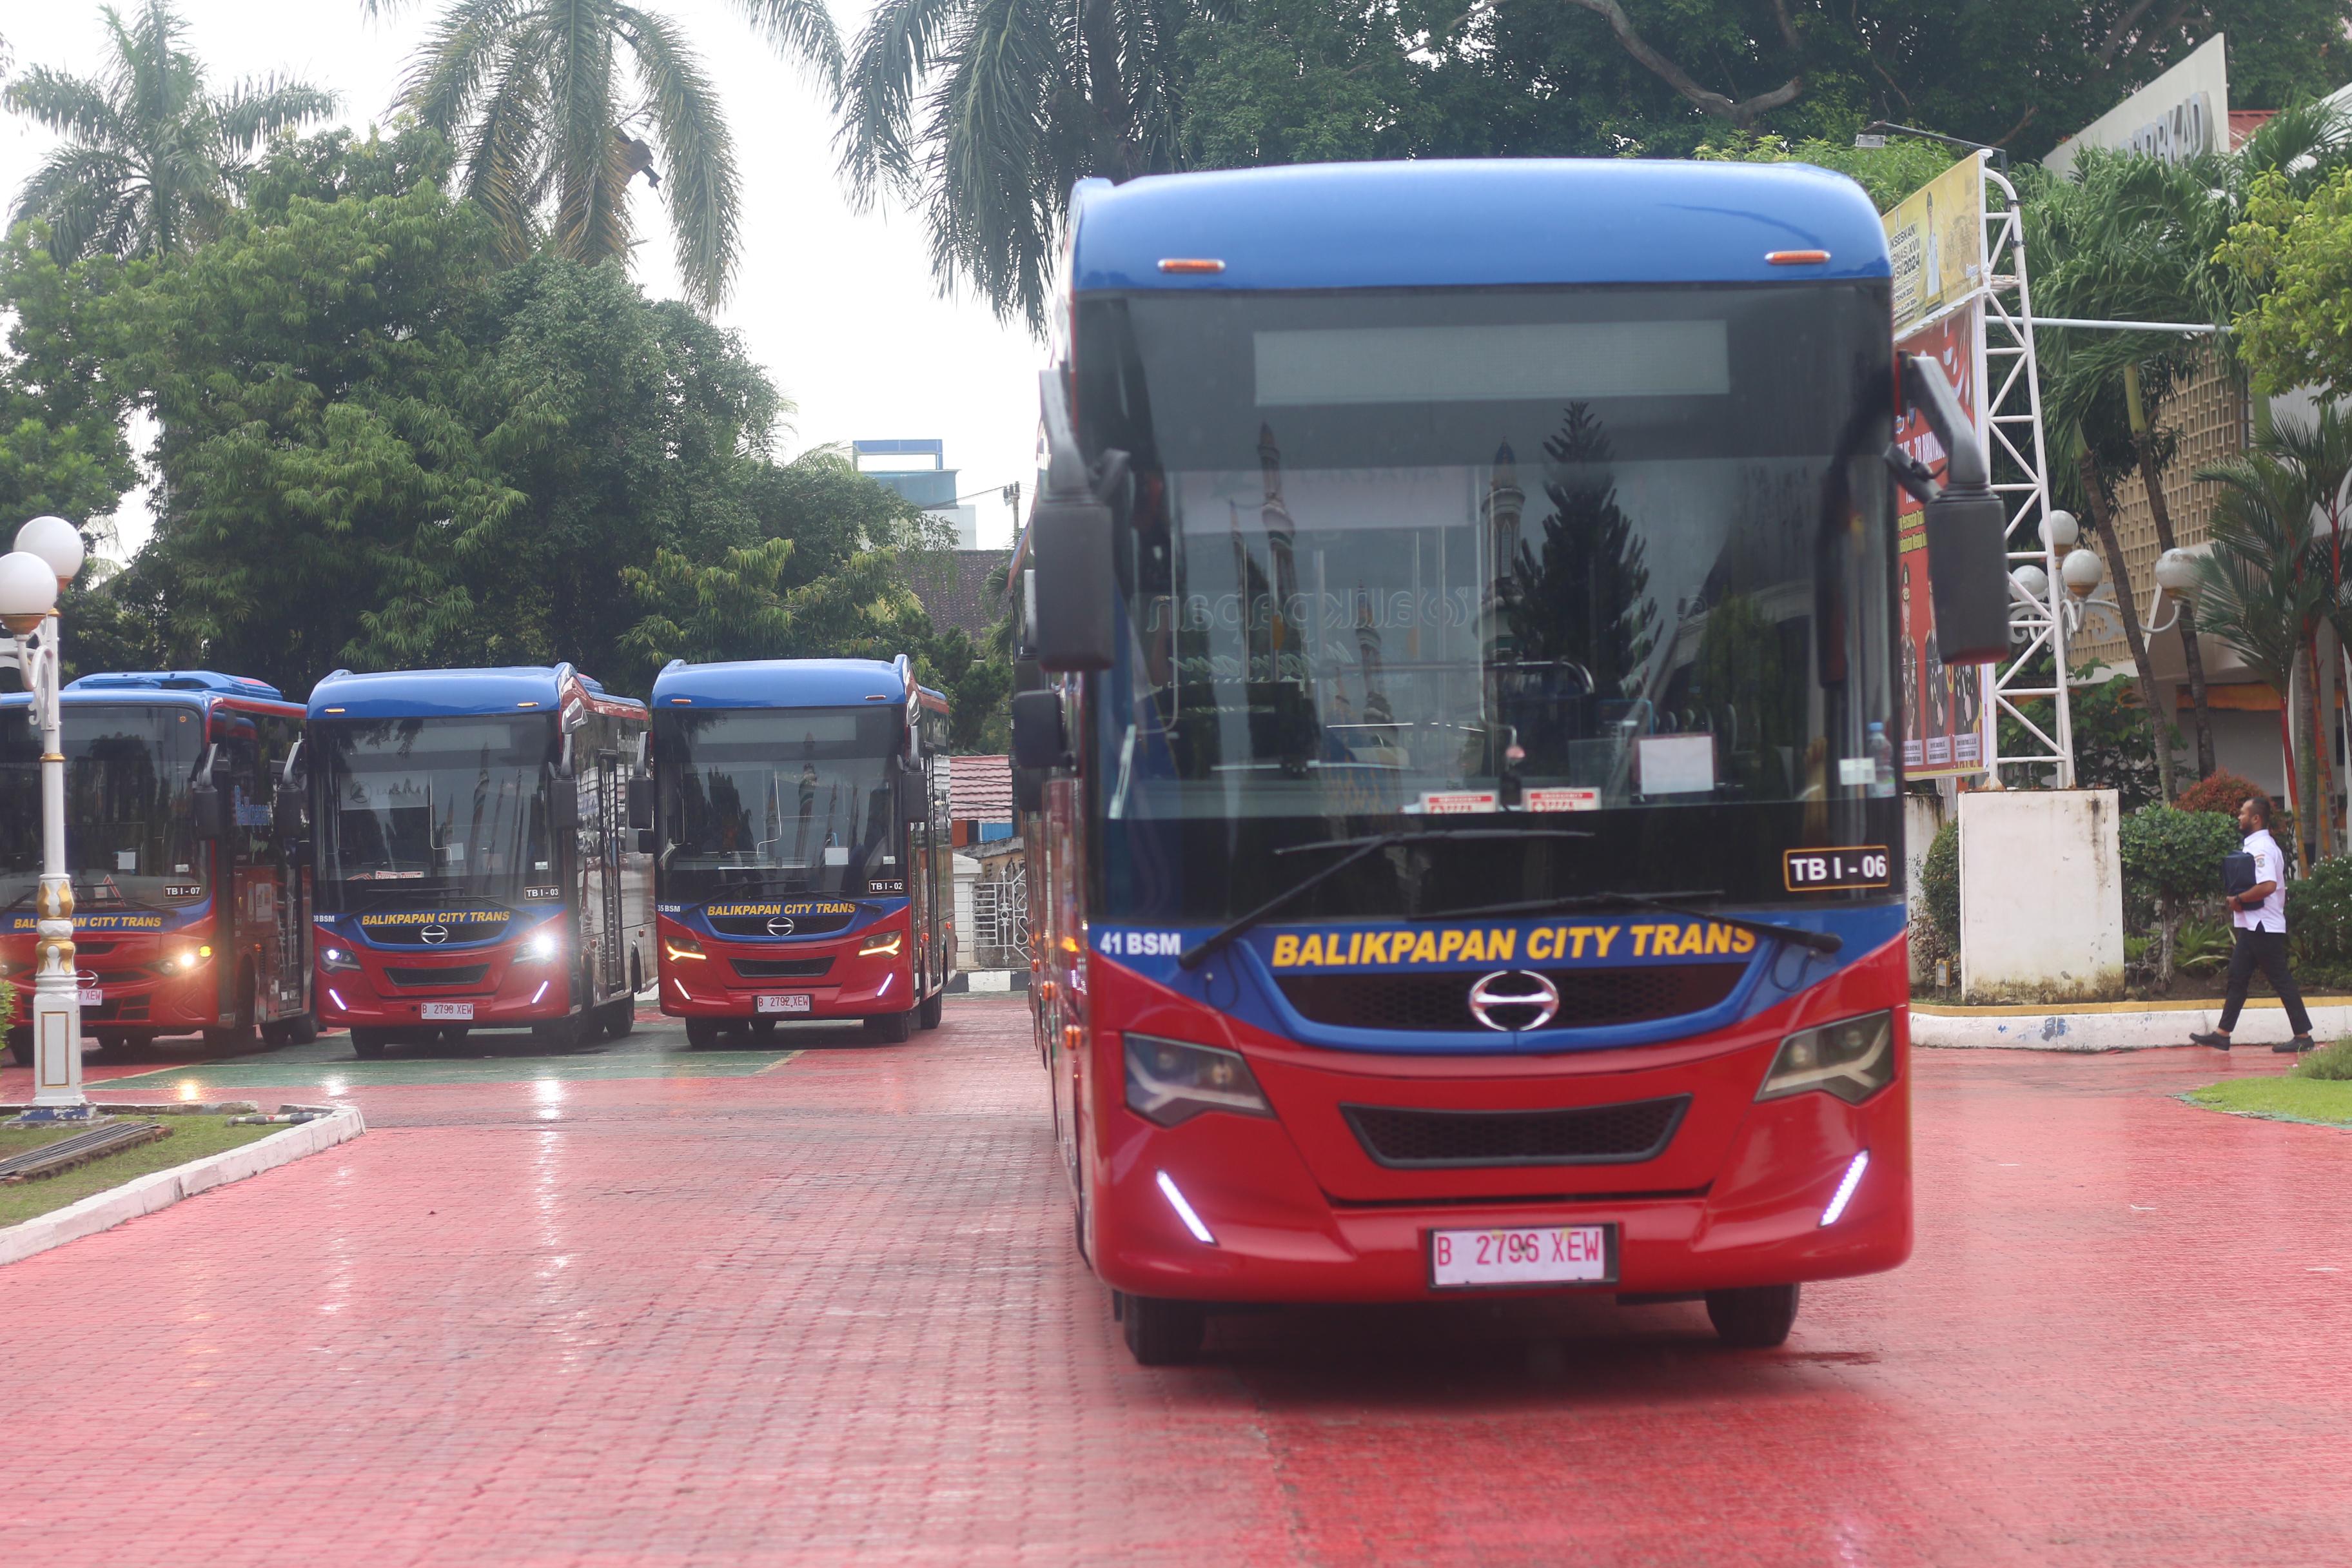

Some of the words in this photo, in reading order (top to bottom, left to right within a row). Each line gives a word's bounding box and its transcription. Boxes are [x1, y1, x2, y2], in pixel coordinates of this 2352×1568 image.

[1888, 223, 1916, 251] UKSESKAN
[1903, 252, 1920, 276] 2024
[1790, 858, 1827, 881] TB
[1862, 856, 1886, 877] 06
[550, 888, 558, 896] 03
[707, 905, 781, 916] BALIKPAPAN
[783, 903, 812, 915] CITY
[816, 903, 856, 914] TRANS
[14, 917, 86, 929] BALIAN
[89, 917, 119, 927] CITY
[121, 917, 161, 927] TRANS
[362, 914, 435, 925] BALIKPAPAN
[438, 913, 466, 923] CITY
[470, 912, 509, 922] TRANS
[1100, 933, 1121, 955] 41
[1127, 933, 1182, 956] BSM
[1272, 929, 1516, 967] BALIKPAPAN
[1526, 926, 1620, 959] CITY
[1629, 925, 1756, 956] TRANS
[86, 990, 101, 1000] XEW
[758, 997, 763, 1007] B
[770, 997, 790, 1007] 2792
[793, 996, 808, 1006] XEW
[422, 1004, 427, 1014] B
[456, 1004, 473, 1014] XEW
[1437, 1237, 1452, 1267] B
[1476, 1233, 1540, 1265] 2796
[1551, 1231, 1600, 1262] XEW
